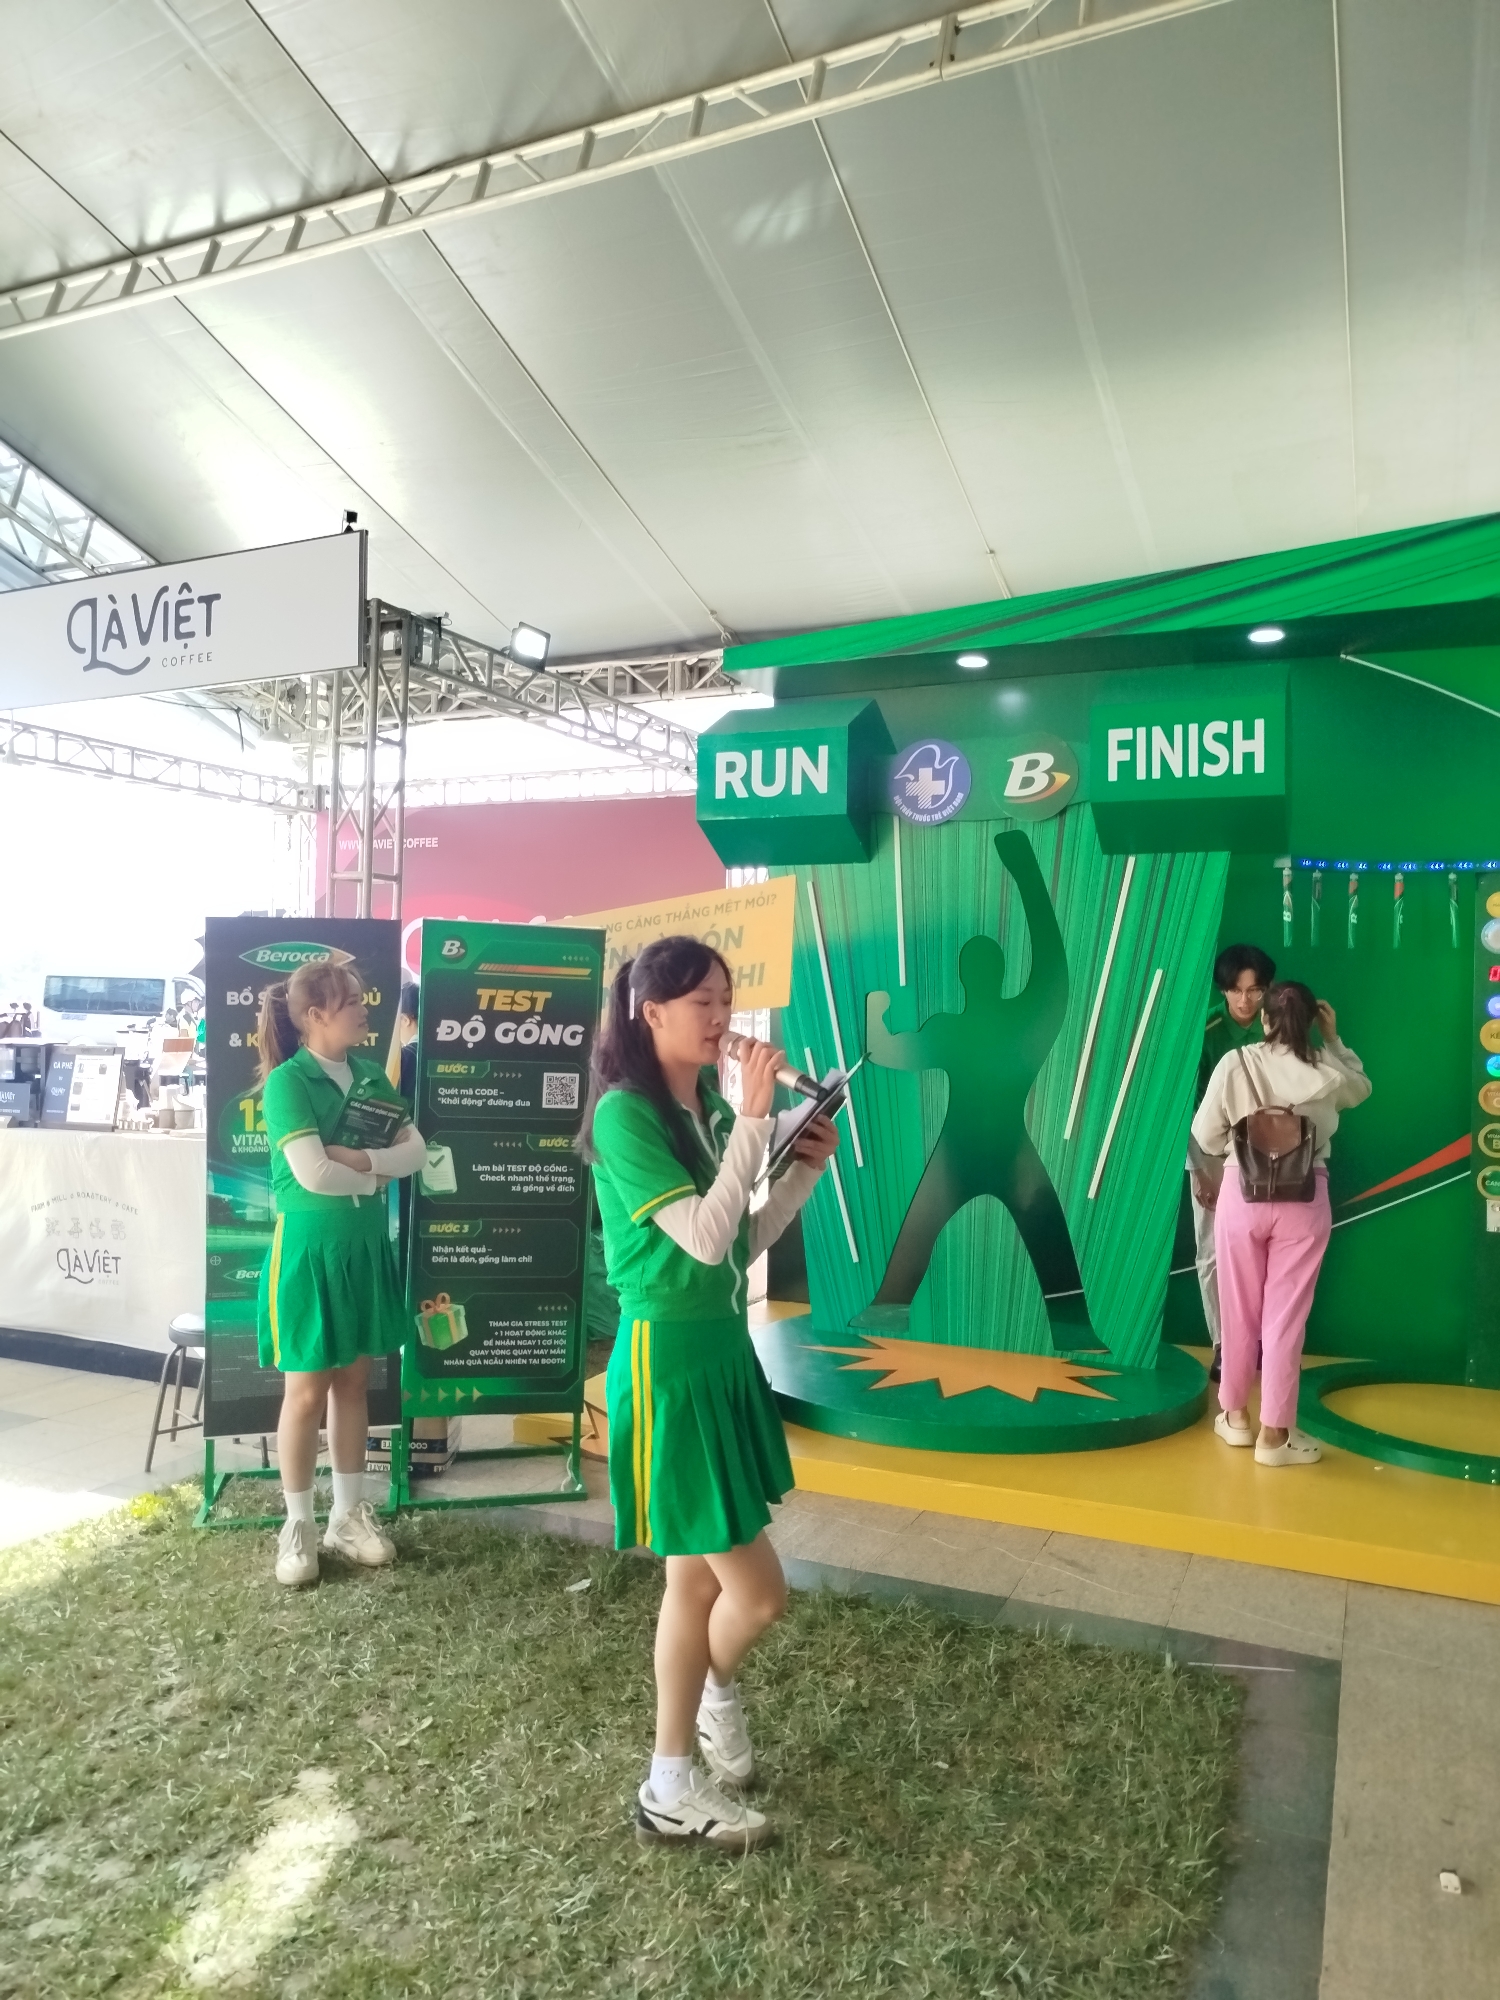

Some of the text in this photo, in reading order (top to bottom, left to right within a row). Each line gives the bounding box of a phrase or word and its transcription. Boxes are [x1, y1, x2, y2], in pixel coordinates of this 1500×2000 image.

[132, 582, 221, 649] VIỆT
[161, 651, 213, 668] COFFEE
[1108, 718, 1265, 782] FINISH
[715, 745, 829, 800] RUN
[912, 812, 931, 822] THUỐC
[942, 804, 955, 817] VIỆT
[952, 792, 965, 807] NAM
[626, 914, 661, 931] CĂNG
[665, 903, 710, 921] THẲNG
[714, 899, 742, 916] MỆT
[744, 891, 777, 909] MỎI?
[256, 949, 331, 963] Berocca
[226, 986, 254, 1006] BỔ
[477, 988, 552, 1013] TEST
[436, 1015, 585, 1049] ĐỘ GỒNG
[436, 1063, 476, 1074] BƯỚC 1
[438, 1087, 459, 1096] Quét
[475, 1088, 499, 1096] CODE
[487, 1099, 514, 1108] đường
[515, 1099, 531, 1107] đua
[539, 1137, 570, 1148] BƯỚC
[472, 1164, 490, 1172] Làm
[492, 1164, 505, 1172] bài
[528, 1164, 542, 1173] ĐỘ
[480, 1174, 506, 1182] Check
[507, 1174, 534, 1182] nhanh
[551, 1175, 576, 1184] trạng,
[557, 1184, 575, 1192] đích
[31, 1191, 139, 1216] FARM MILL ROASTERY CAFE
[429, 1223, 470, 1233] BƯỚC 3
[432, 1246, 454, 1254] Nhận
[456, 1245, 469, 1253] kết
[450, 1255, 458, 1263] là
[501, 1255, 516, 1263] làm
[525, 1329, 546, 1337] ĐỘNG
[495, 1339, 516, 1347] NHẬN
[469, 1349, 490, 1357] QUAY
